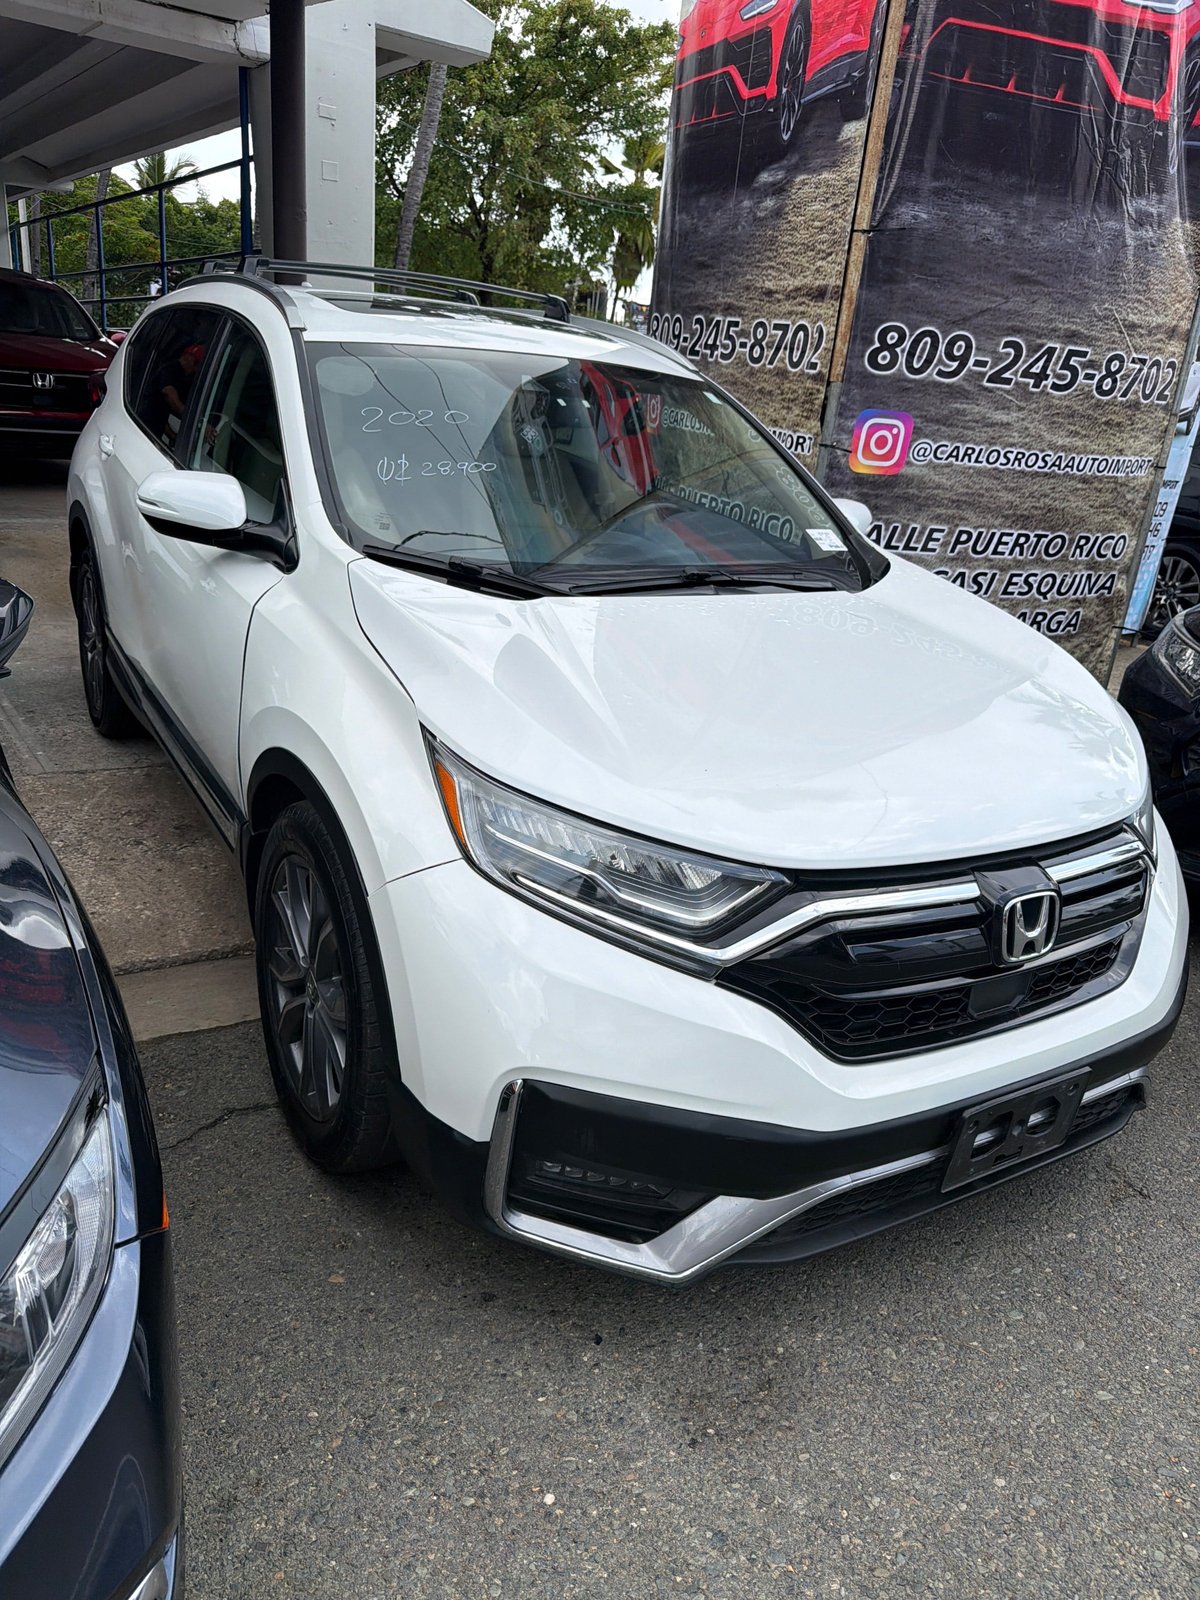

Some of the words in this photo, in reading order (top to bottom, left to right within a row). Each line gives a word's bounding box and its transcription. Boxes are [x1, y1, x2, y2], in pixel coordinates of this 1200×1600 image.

[651, 313, 826, 373] 809-245-8702
[866, 323, 1177, 403] 809-245-8702
[361, 406, 469, 432] 2020
[421, 460, 497, 477] 28,900
[911, 441, 1153, 476] @CARLOSROSAAUTOIMPORT
[747, 506, 795, 543] RICO
[866, 523, 946, 553] ALLE
[949, 528, 1068, 559] PUERTO
[1069, 532, 1128, 560] RICO
[1000, 571, 1117, 600] ESQUINA
[1015, 609, 1082, 635] ARGA
